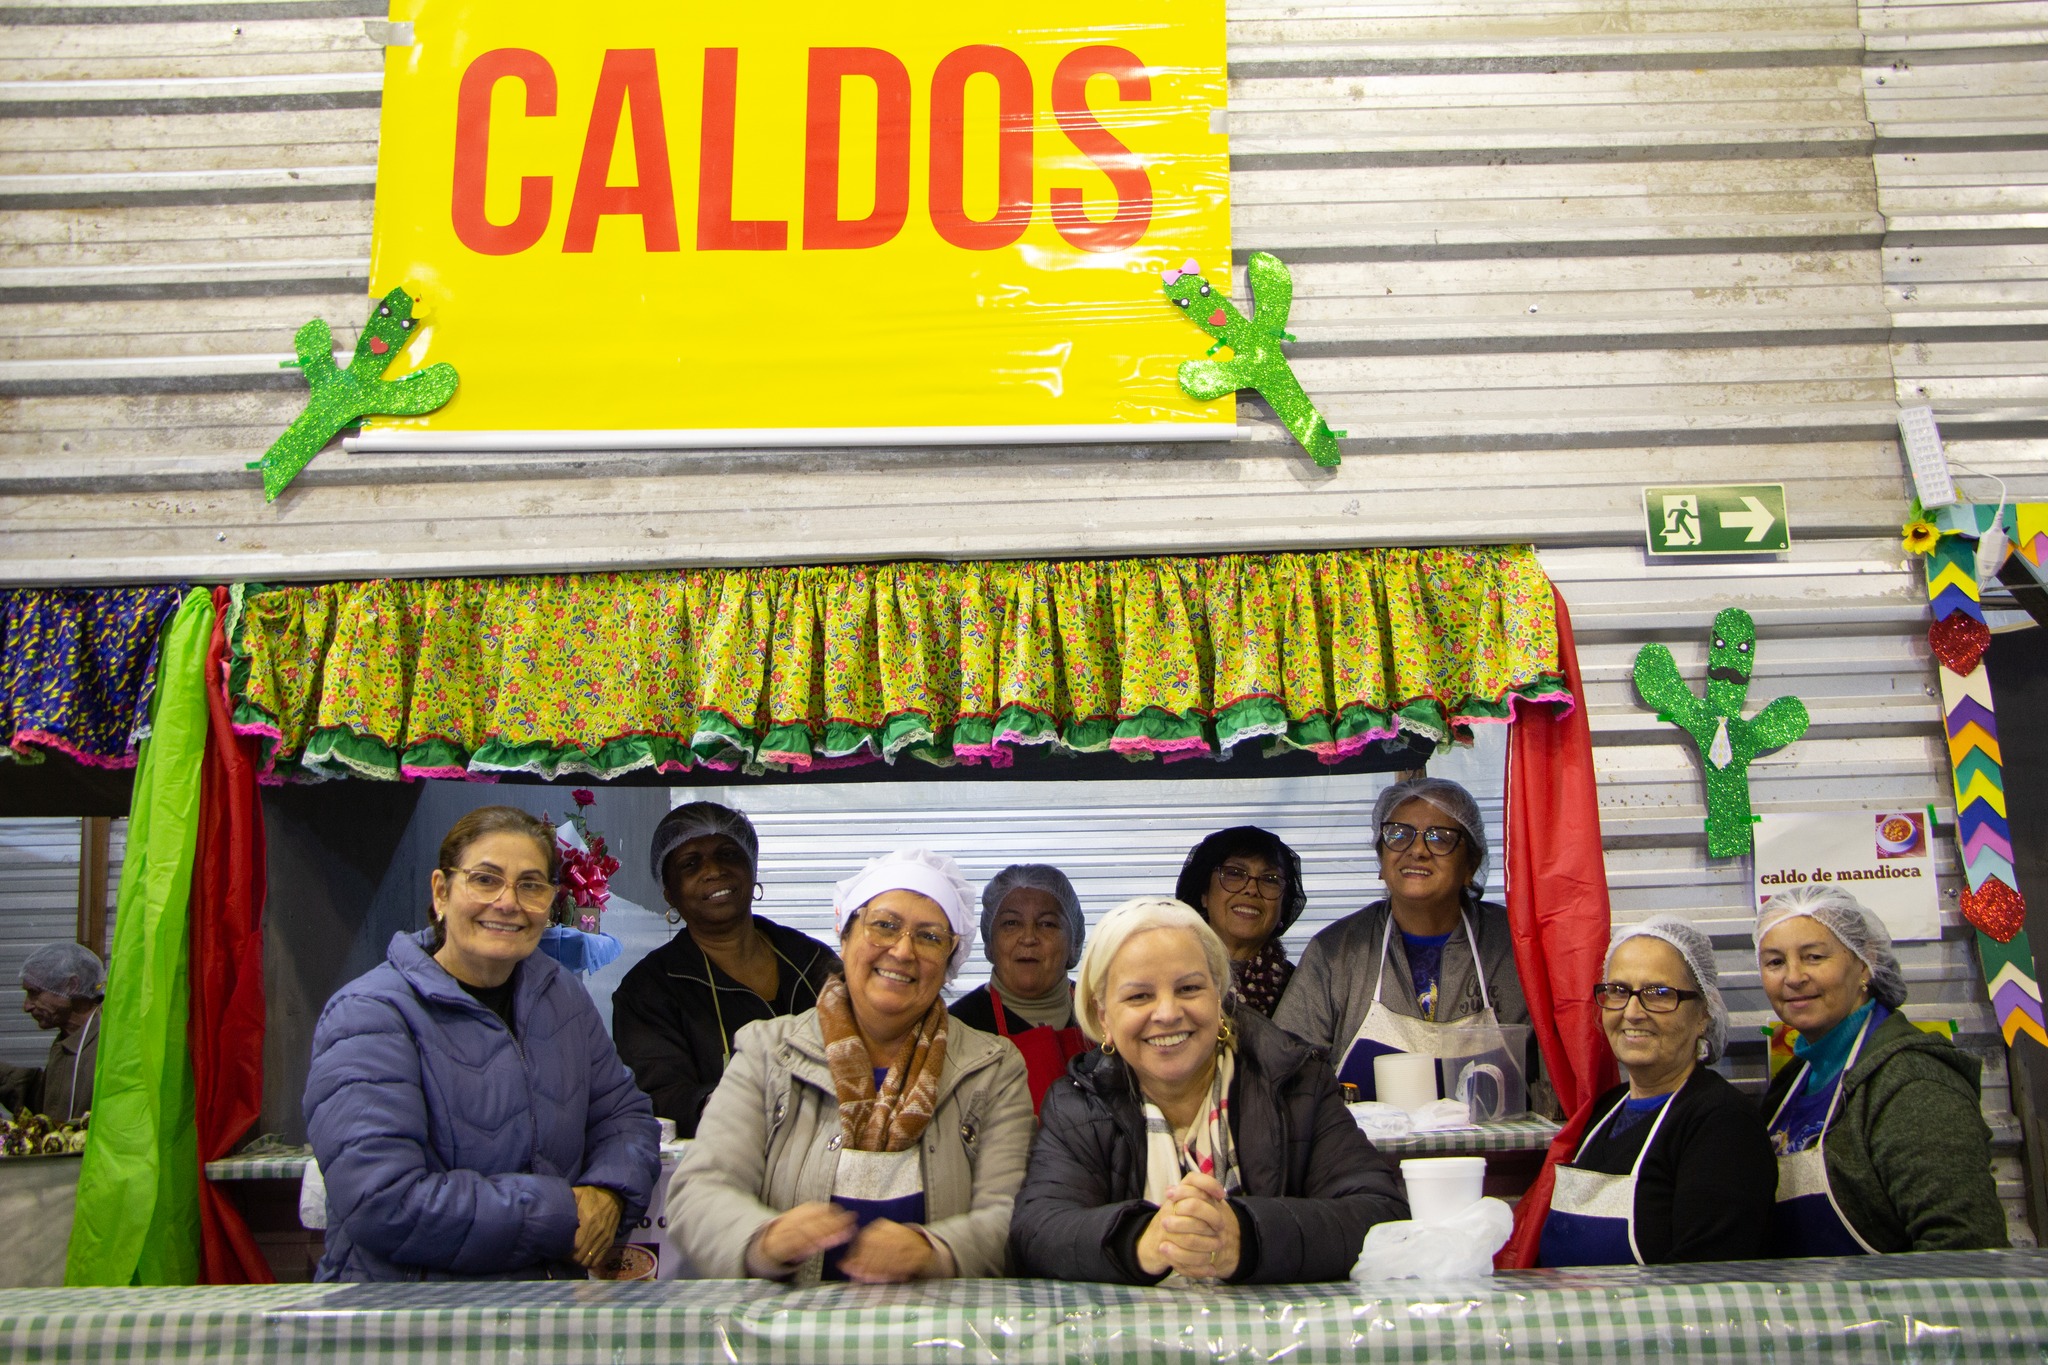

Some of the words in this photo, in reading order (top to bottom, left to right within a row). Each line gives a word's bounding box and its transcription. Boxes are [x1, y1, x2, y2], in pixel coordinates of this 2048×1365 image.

[451, 44, 1152, 255] CALDOS
[1760, 870, 1807, 885] caldo
[1811, 867, 1832, 882] de
[1837, 865, 1921, 881] mandioca
